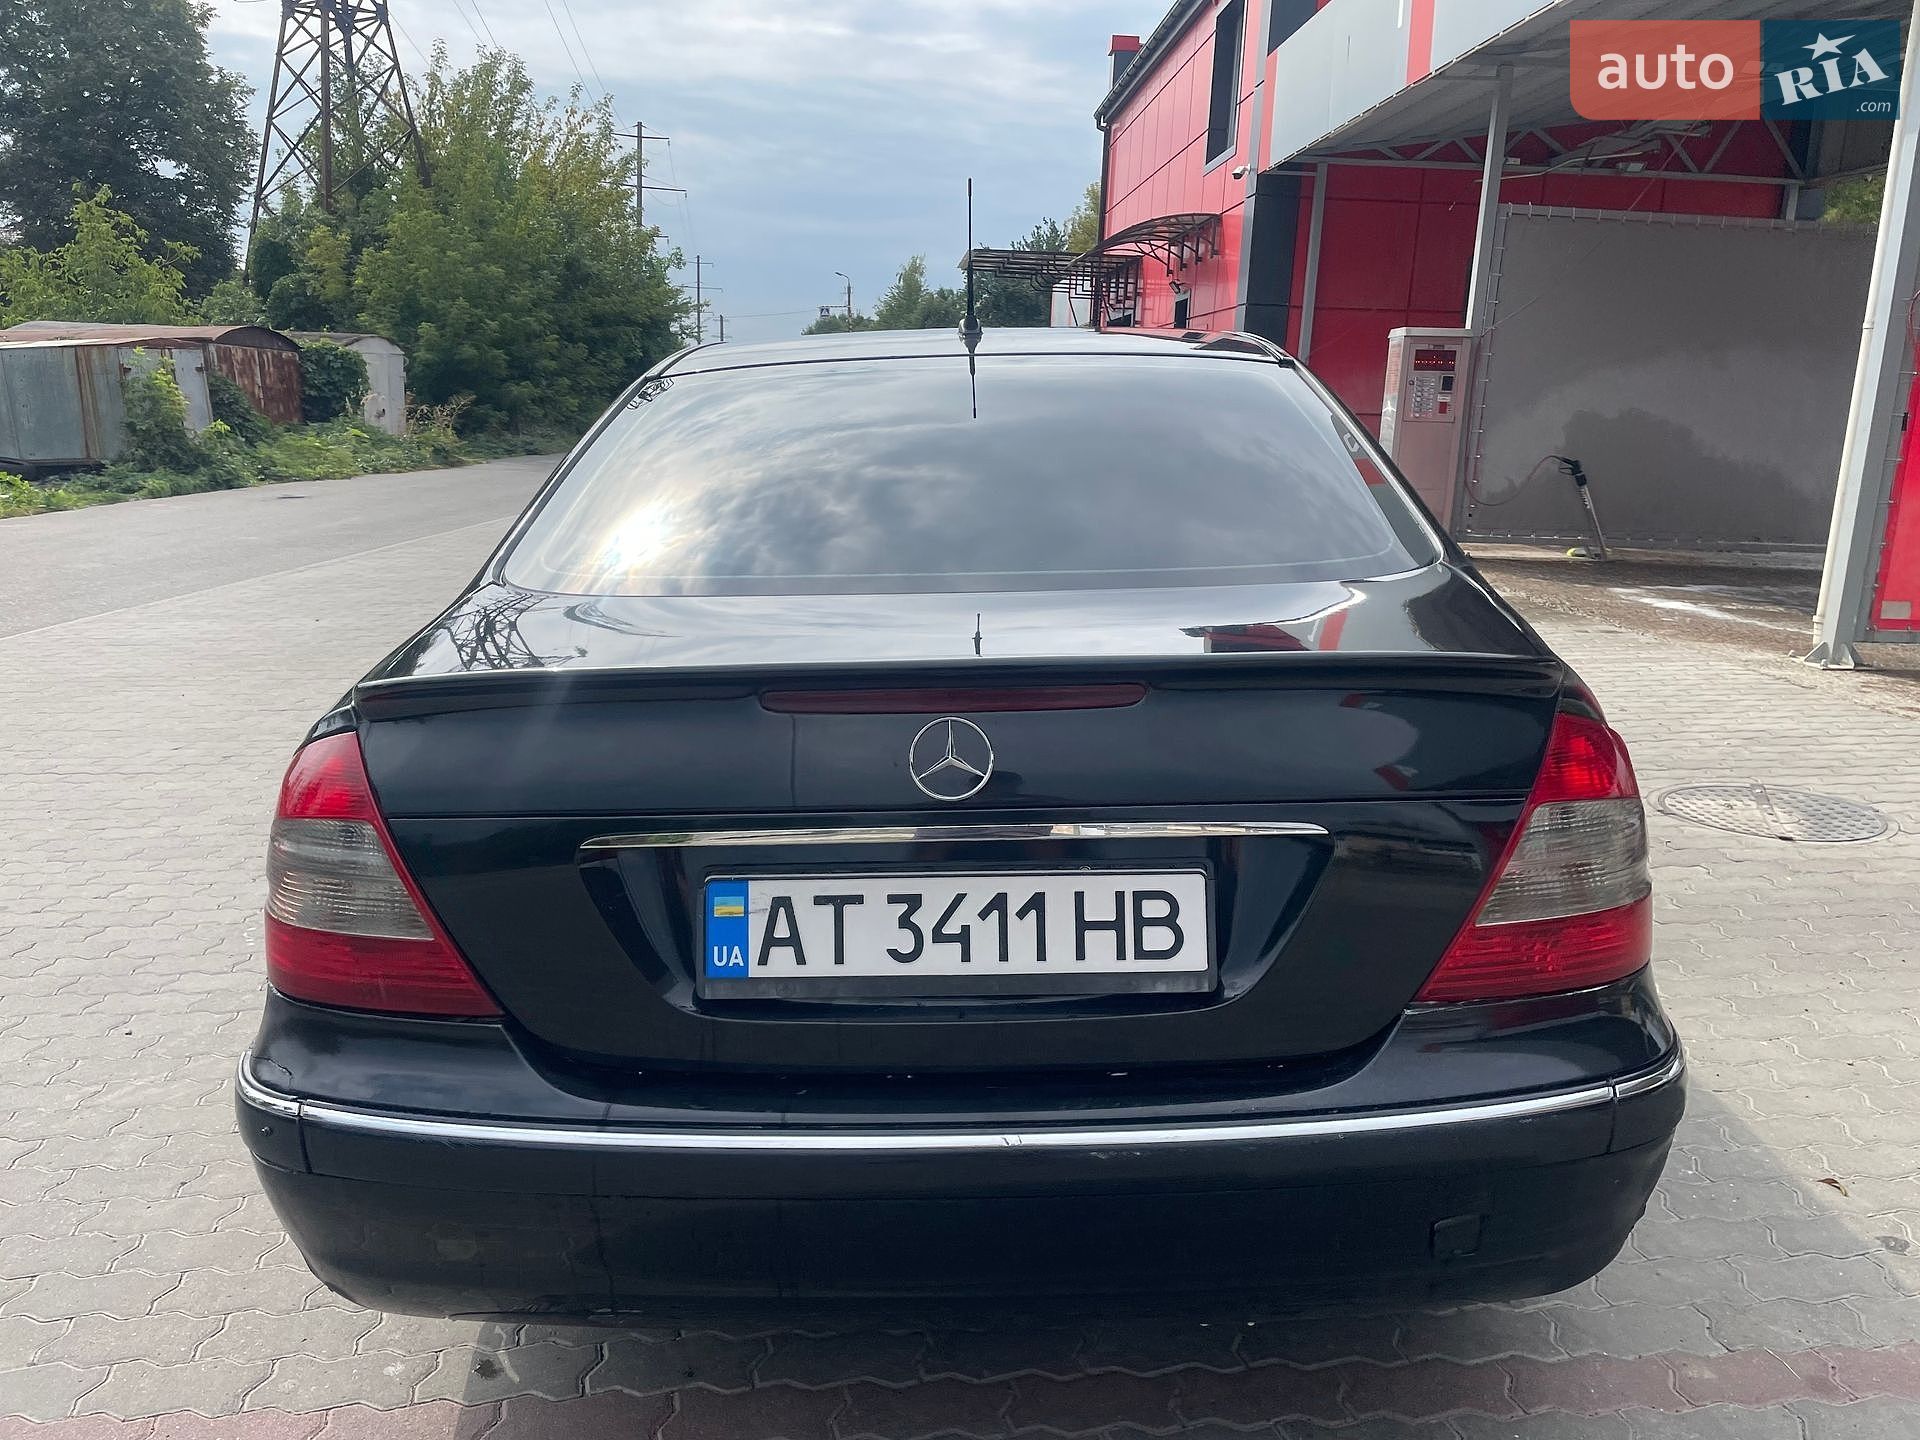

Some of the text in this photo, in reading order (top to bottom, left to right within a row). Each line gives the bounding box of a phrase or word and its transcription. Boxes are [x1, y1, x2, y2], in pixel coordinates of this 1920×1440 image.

[757, 890, 1185, 966] AT 3411 HB
[713, 945, 744, 967] UA
